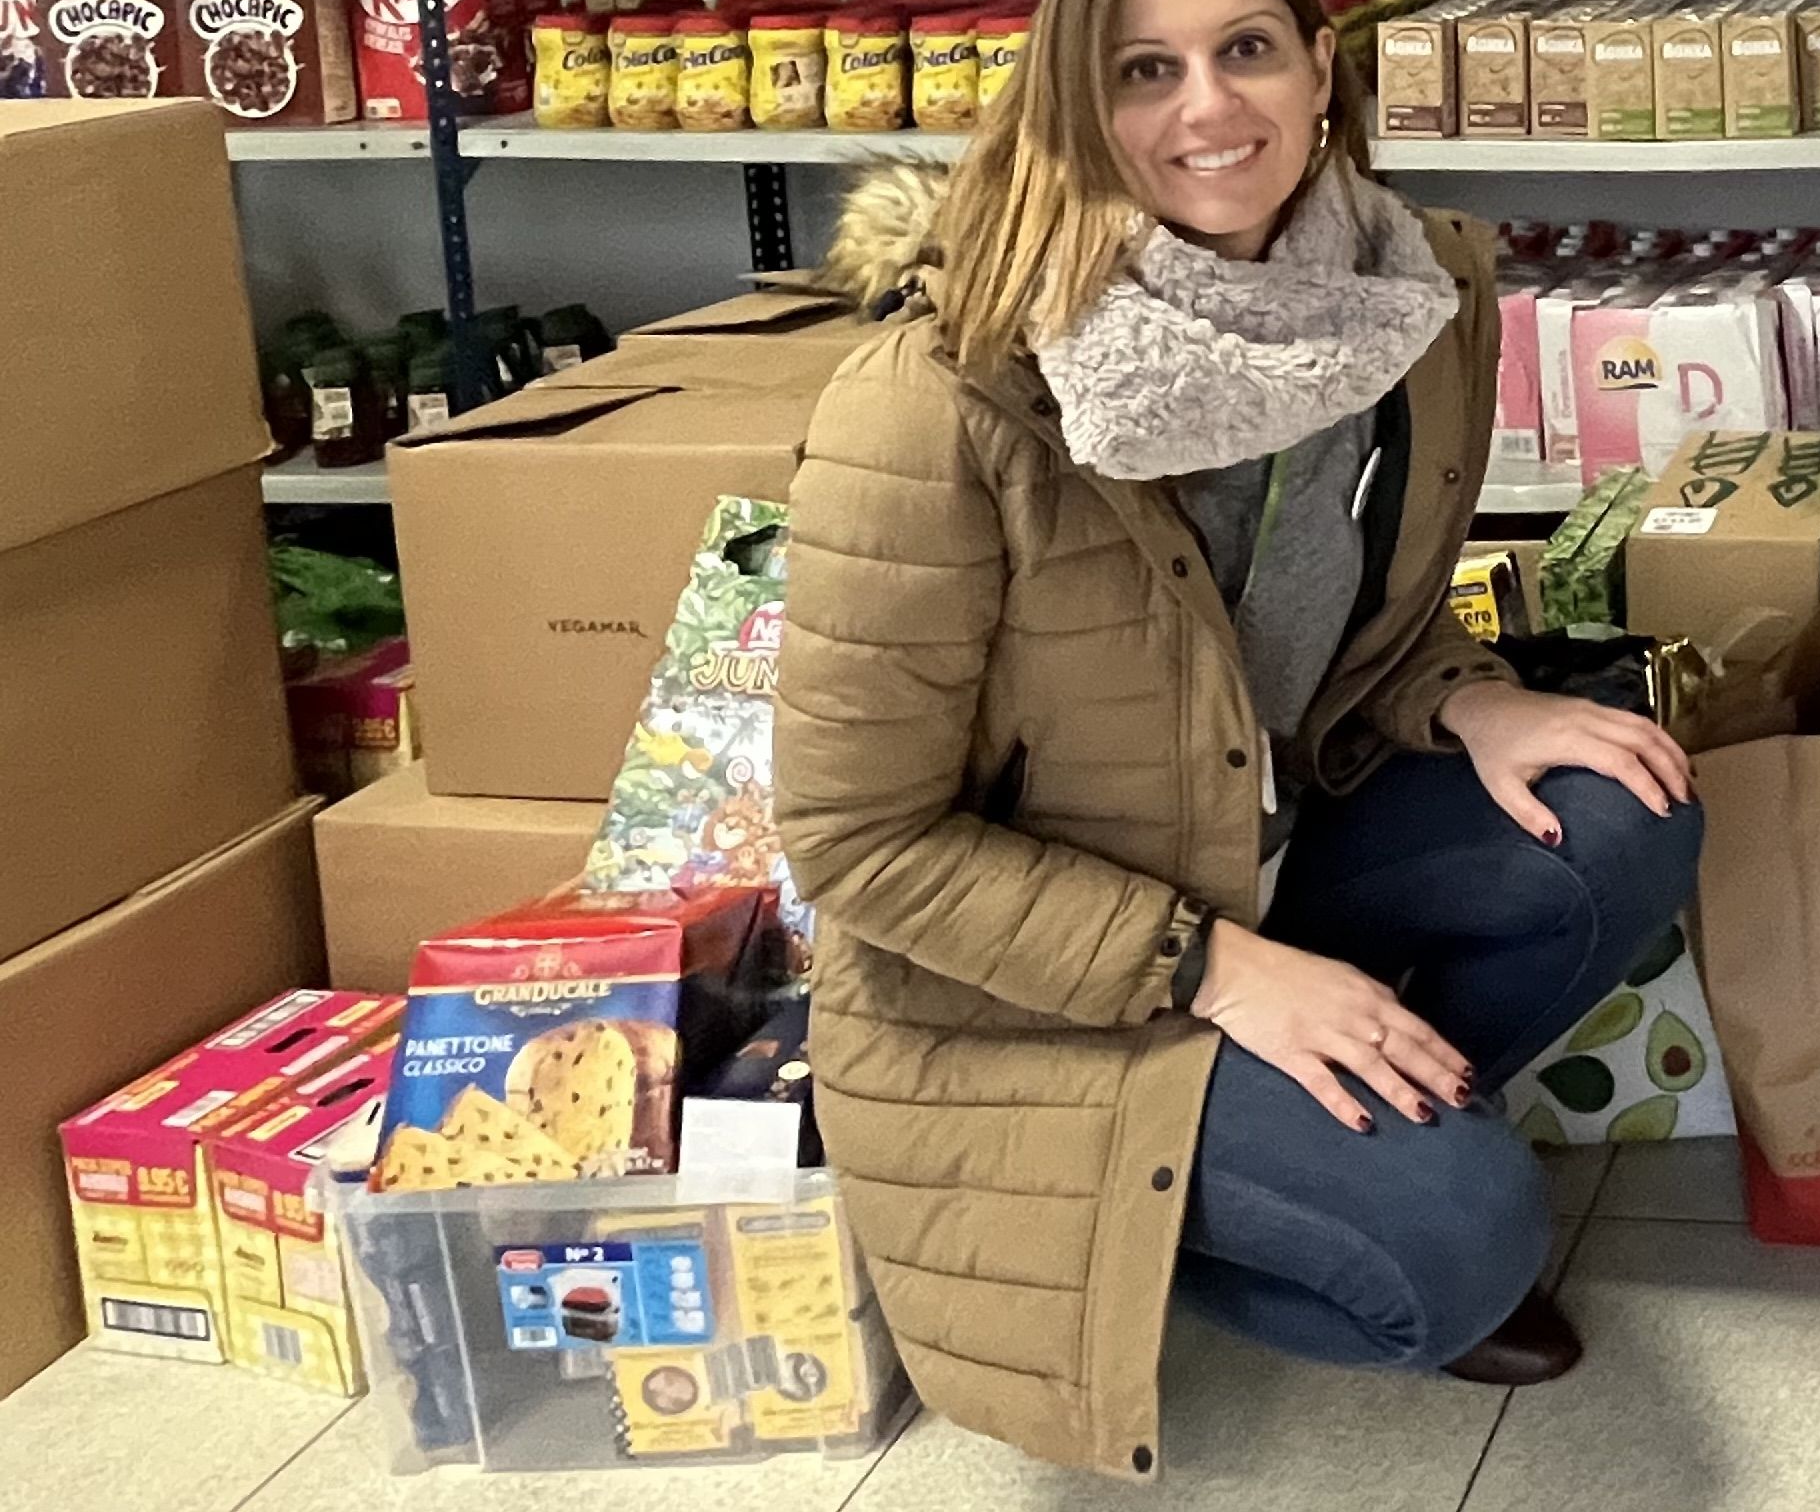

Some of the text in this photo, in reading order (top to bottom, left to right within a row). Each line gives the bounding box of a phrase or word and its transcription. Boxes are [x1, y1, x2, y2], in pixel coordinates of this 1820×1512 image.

[56, 0, 159, 35] CHOCAPIC
[1601, 357, 1656, 381] RAM
[547, 618, 649, 639] VEGAMAR
[404, 1033, 516, 1057] PANETTONE
[402, 1056, 487, 1078] CLASSICO
